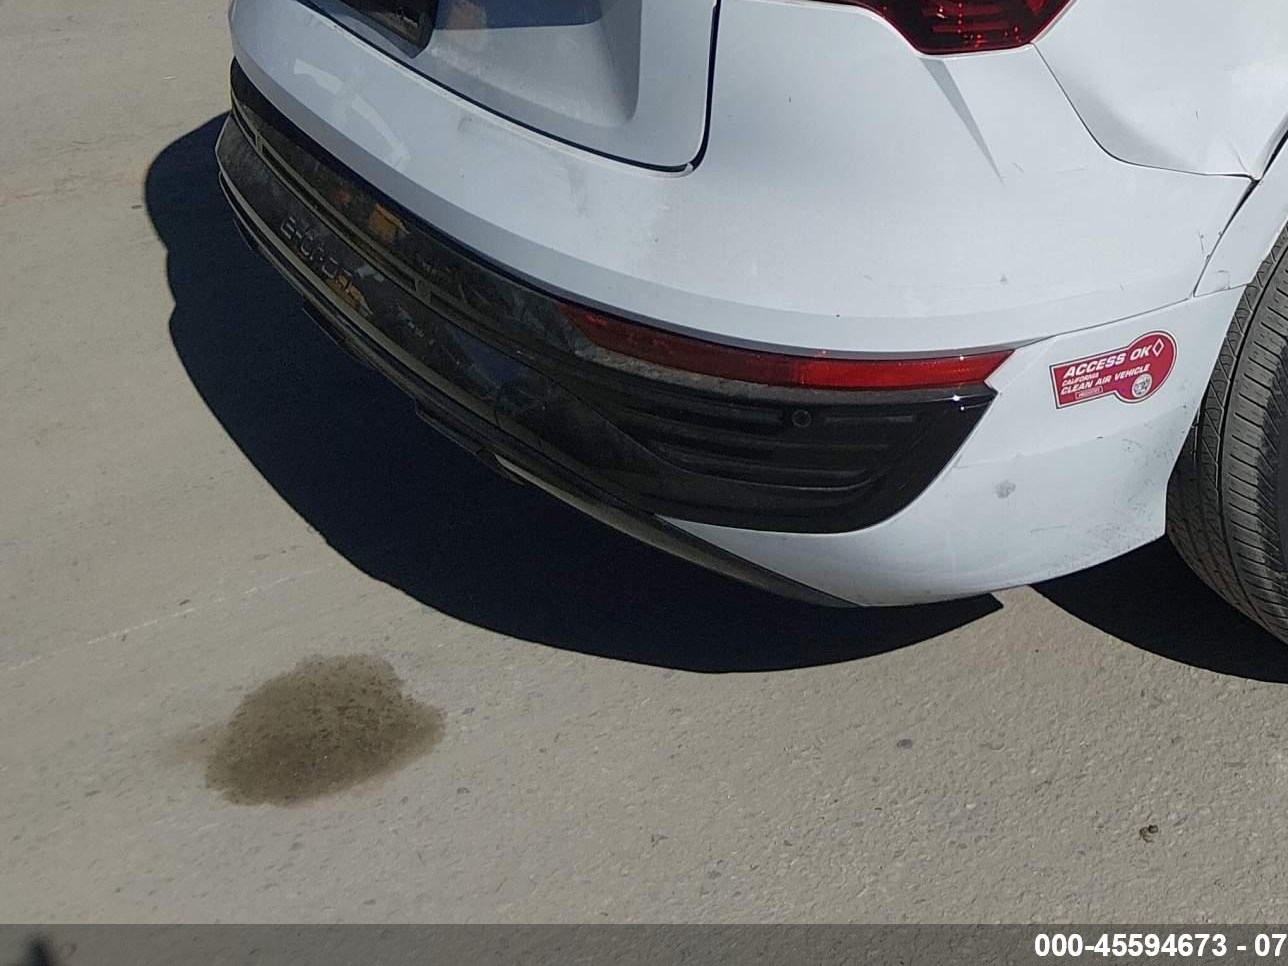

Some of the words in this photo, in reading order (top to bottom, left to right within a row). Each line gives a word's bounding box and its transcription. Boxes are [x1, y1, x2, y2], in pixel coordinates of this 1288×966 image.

[1063, 352, 1126, 379] ACCESS
[1130, 344, 1152, 361] OK
[1060, 380, 1093, 395] CLEAN
[1096, 375, 1111, 386] AIR
[1114, 363, 1150, 381] VEHICLE
[1062, 372, 1099, 386] CALIFORNIA
